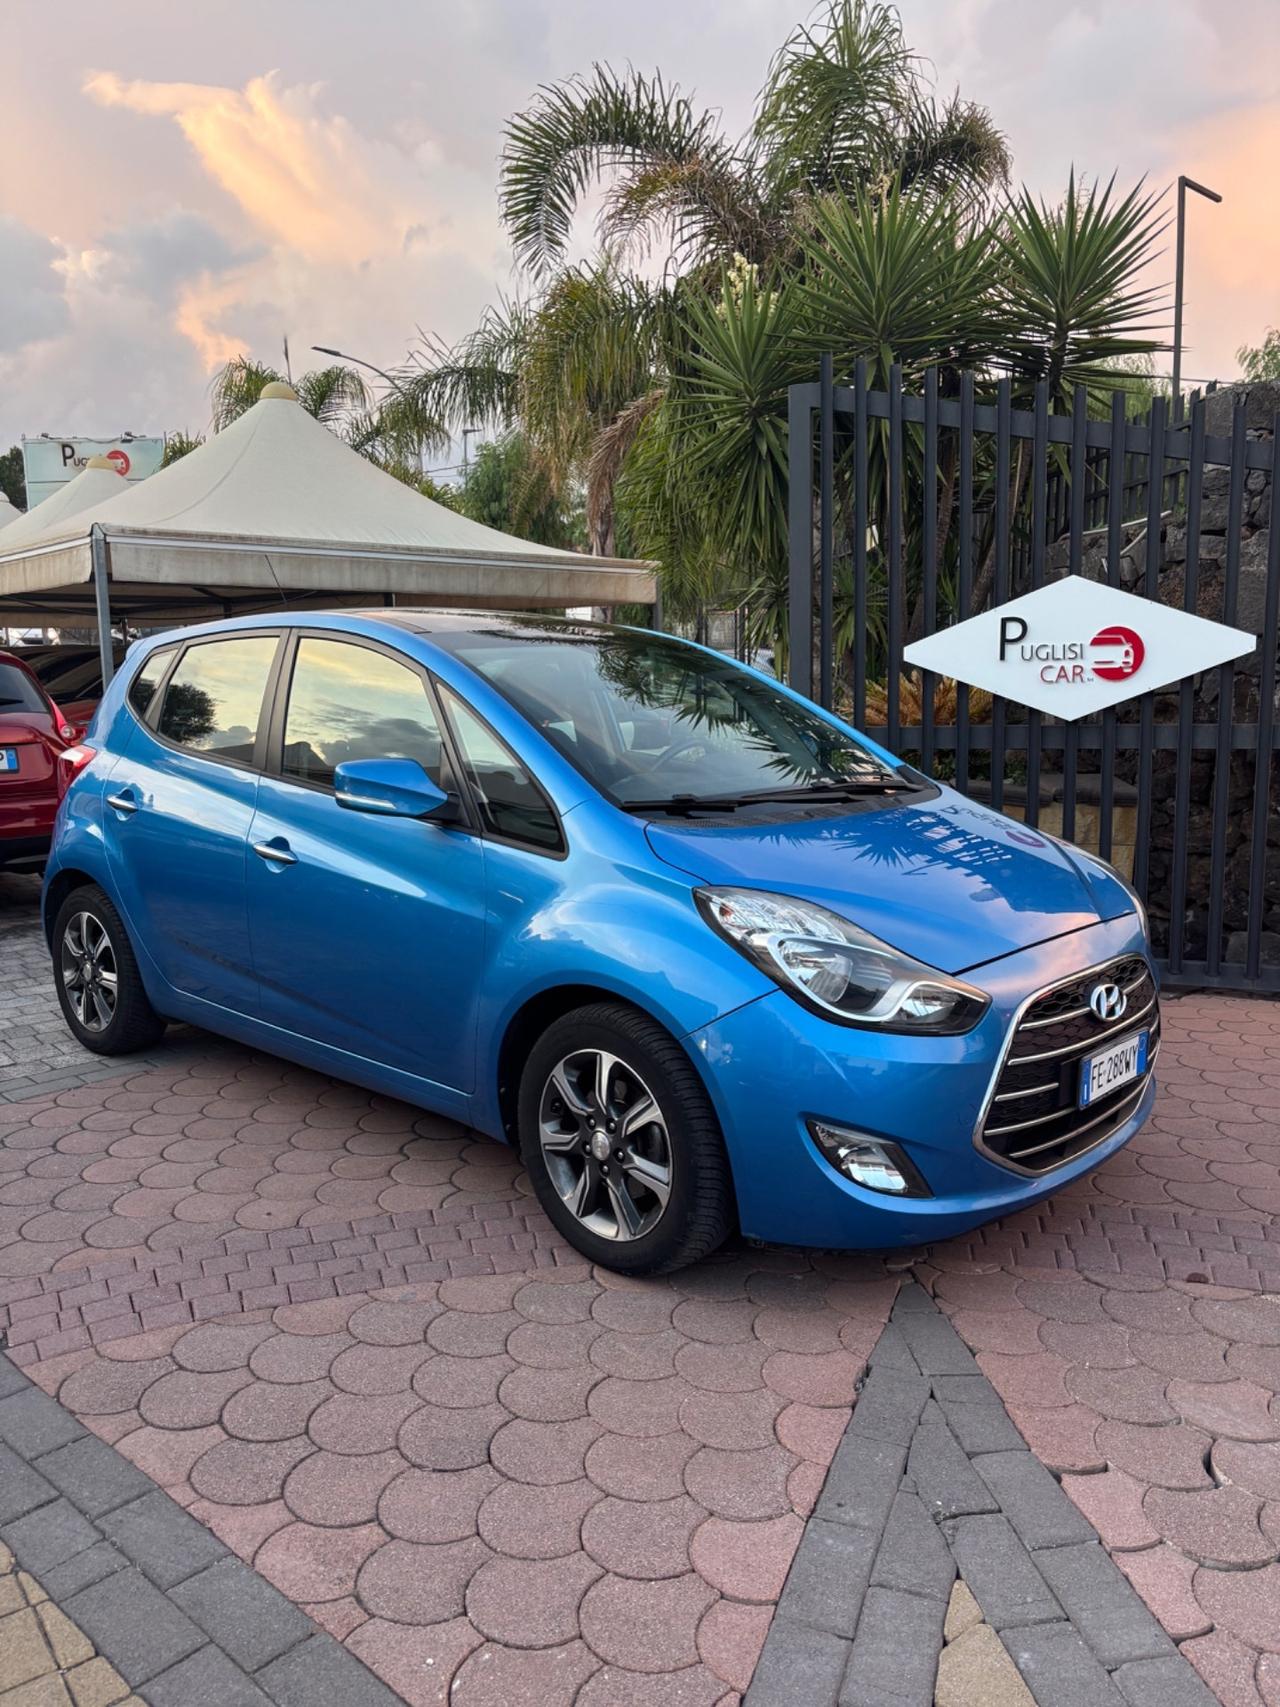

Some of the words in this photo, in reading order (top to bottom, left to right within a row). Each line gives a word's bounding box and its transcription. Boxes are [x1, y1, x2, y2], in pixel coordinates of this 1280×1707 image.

[61, 444, 89, 467] PUG
[1000, 616, 1084, 661] PUGLISI
[1040, 665, 1085, 683] CAR
